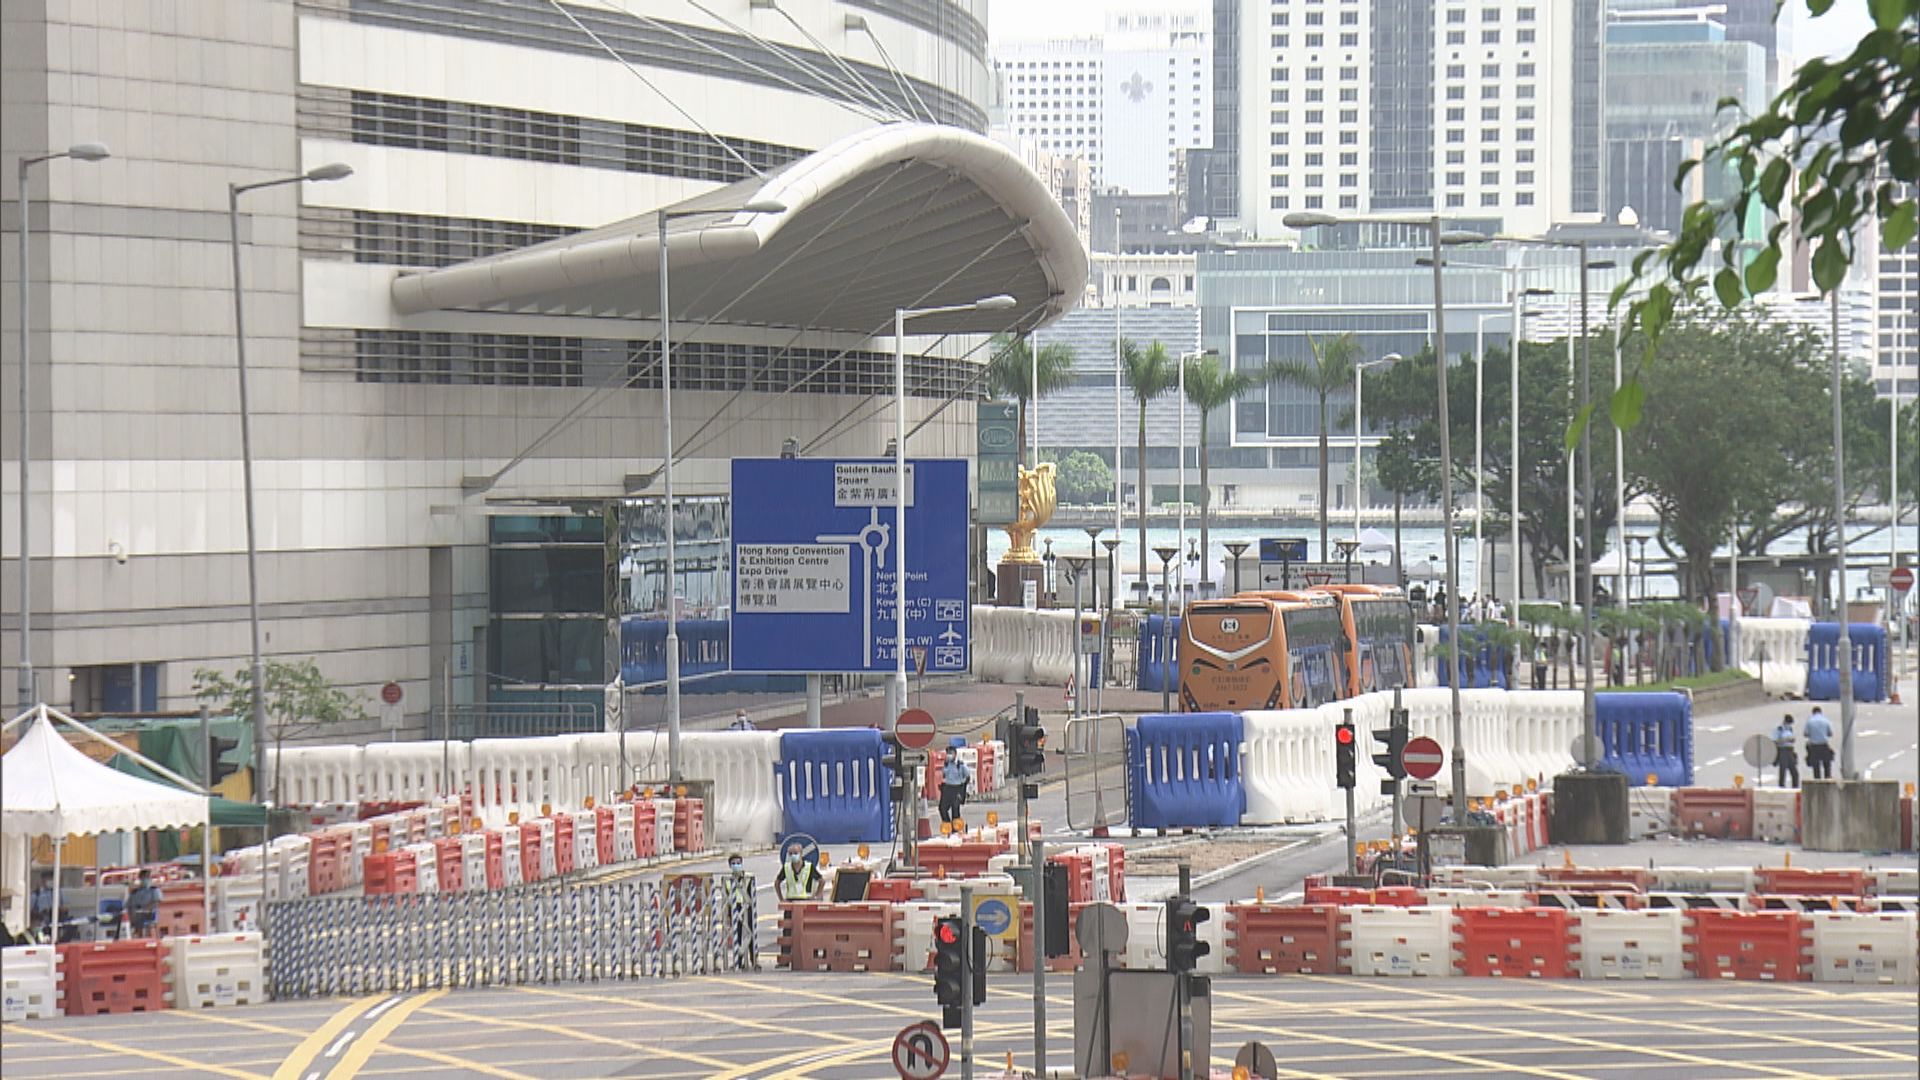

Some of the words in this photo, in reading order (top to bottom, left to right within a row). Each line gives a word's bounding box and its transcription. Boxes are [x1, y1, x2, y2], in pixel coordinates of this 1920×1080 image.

[836, 466, 869, 474] Golden
[836, 476, 869, 485] Square
[739, 546, 763, 556] Hong
[766, 546, 789, 556] Kong
[792, 546, 845, 555] Convention
[739, 556, 746, 565] &
[749, 556, 795, 565] Exhibition
[798, 557, 829, 565] Centre
[739, 567, 762, 576] Expo
[765, 567, 789, 575] Drive
[876, 572, 897, 581] Nort
[904, 572, 928, 581] Point
[916, 635, 933, 646] (W)
